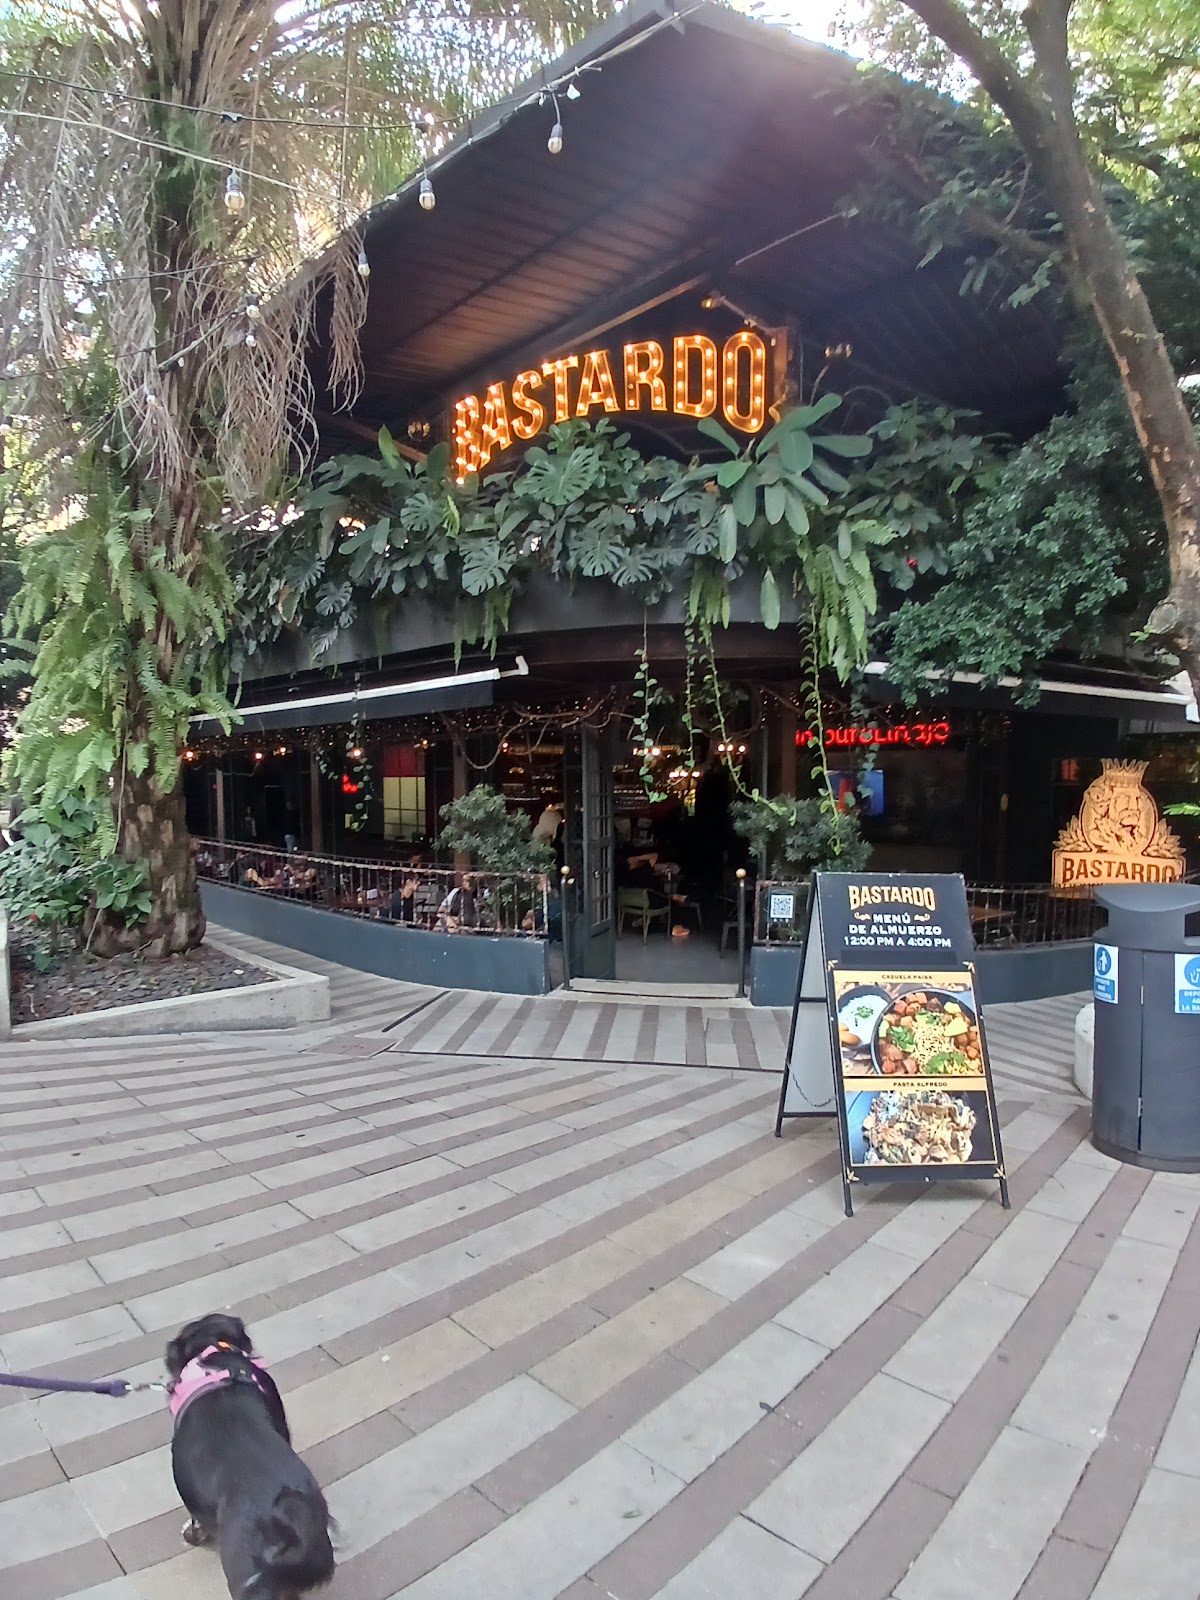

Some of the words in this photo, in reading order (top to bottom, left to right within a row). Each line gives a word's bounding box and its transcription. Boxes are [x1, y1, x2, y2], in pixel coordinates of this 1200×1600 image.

[453, 330, 767, 486] BASTARDO
[1061, 857, 1176, 884] BASTARDO
[848, 885, 936, 912] BASTARDO
[872, 912, 911, 924] MENÚ
[848, 924, 867, 935] DE
[870, 925, 942, 936] ALMUERZO
[844, 936, 875, 946] 12:00
[876, 936, 894, 946] PM
[896, 937, 905, 946] A
[907, 937, 932, 947] 4:00
[934, 938, 952, 948] PM
